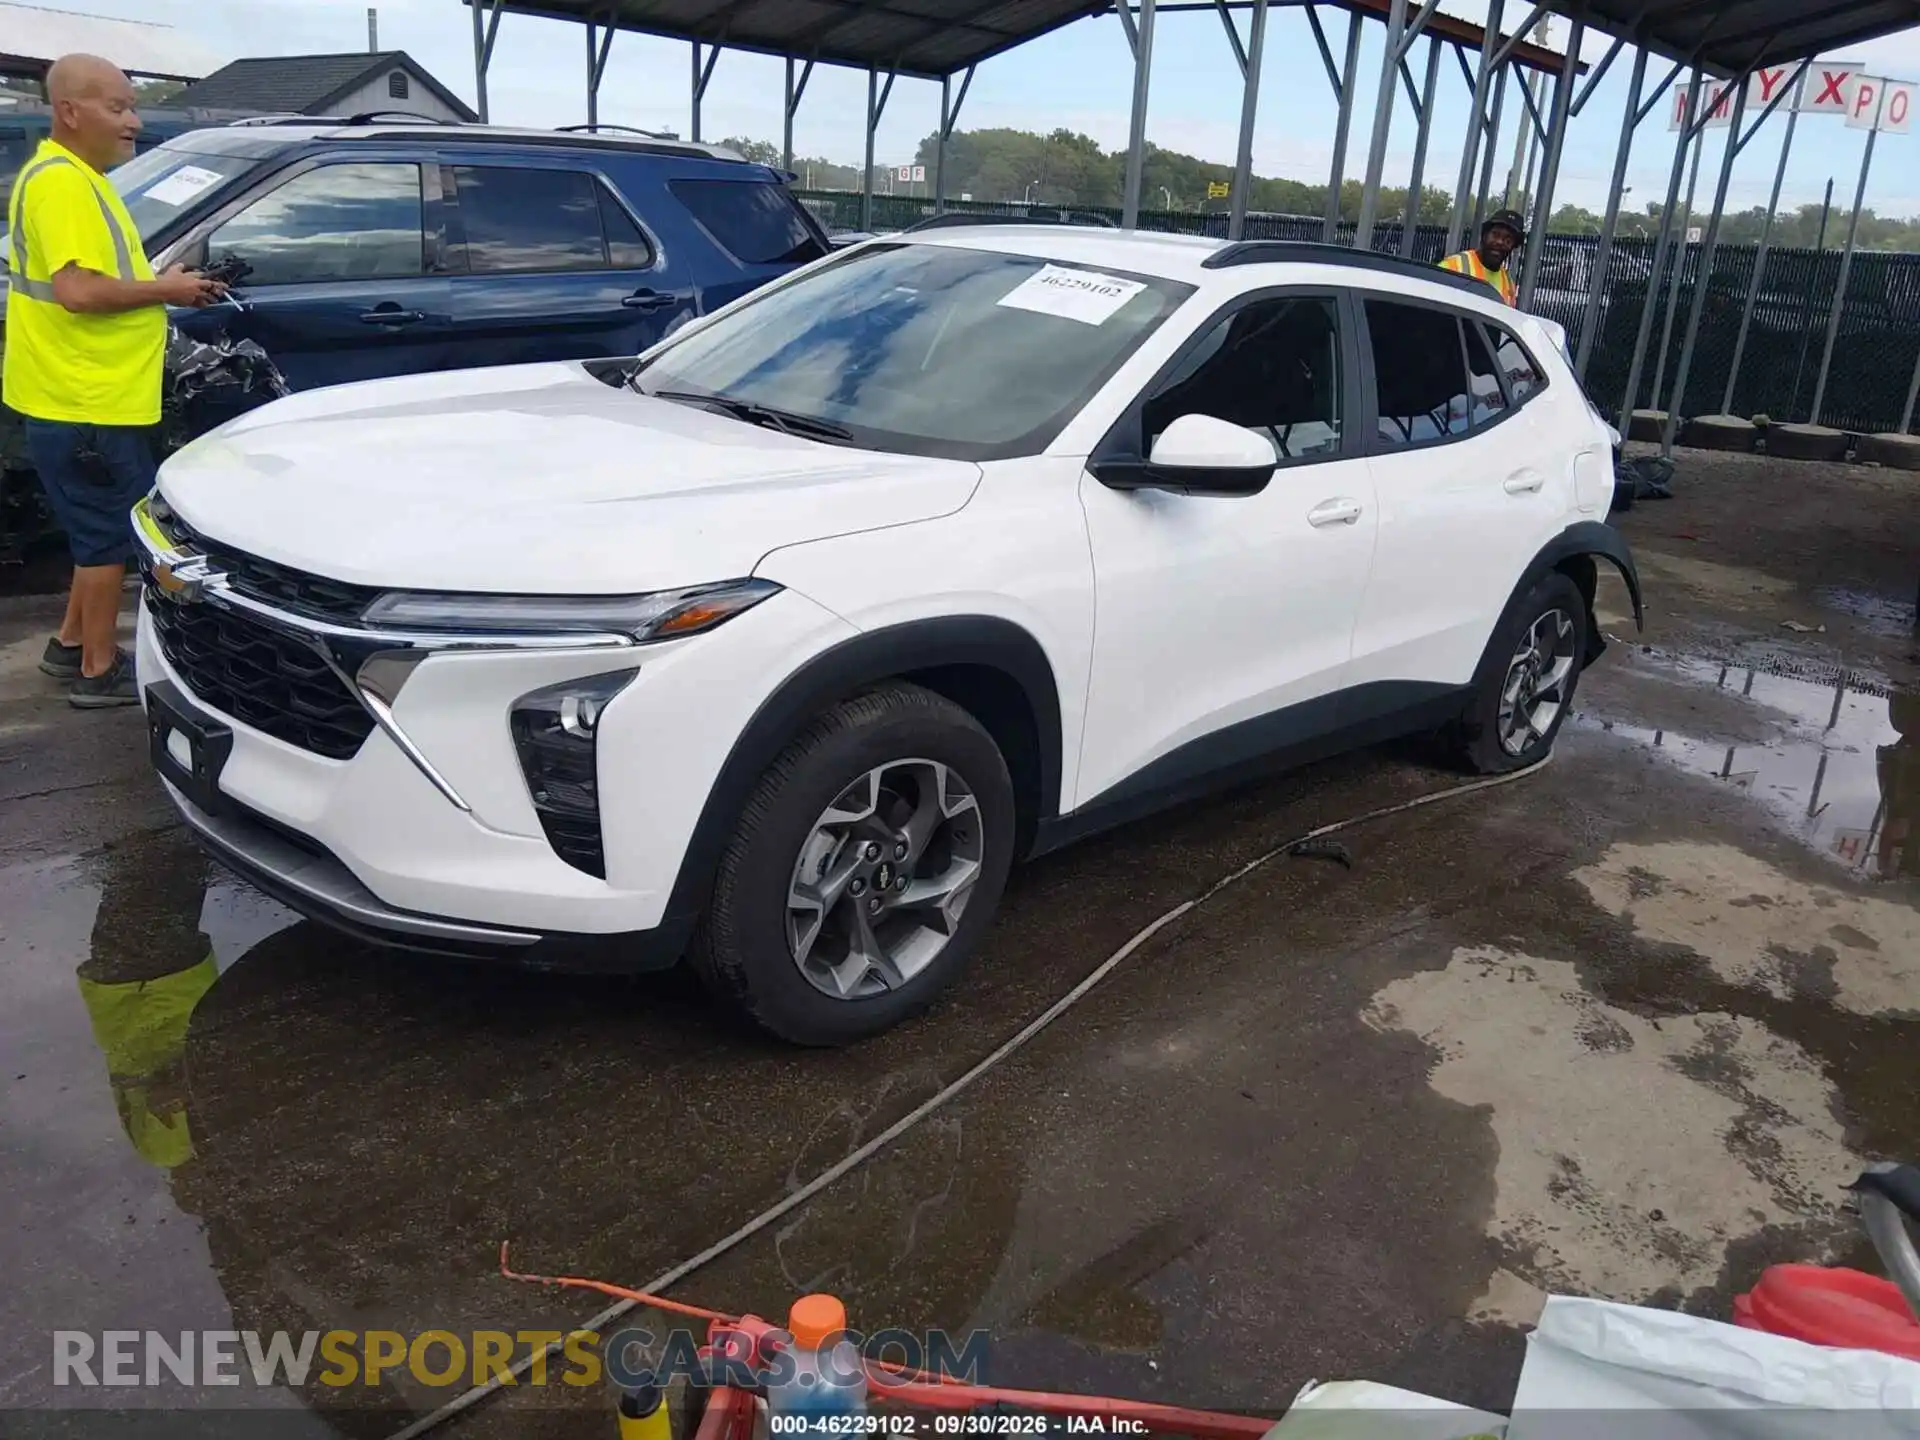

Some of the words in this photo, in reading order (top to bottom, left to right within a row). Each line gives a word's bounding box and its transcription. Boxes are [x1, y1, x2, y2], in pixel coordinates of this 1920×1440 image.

[1758, 69, 1785, 101] Y
[1814, 72, 1849, 104] X
[1854, 85, 1874, 118] P
[1889, 90, 1908, 124] O
[900, 167, 909, 179] G
